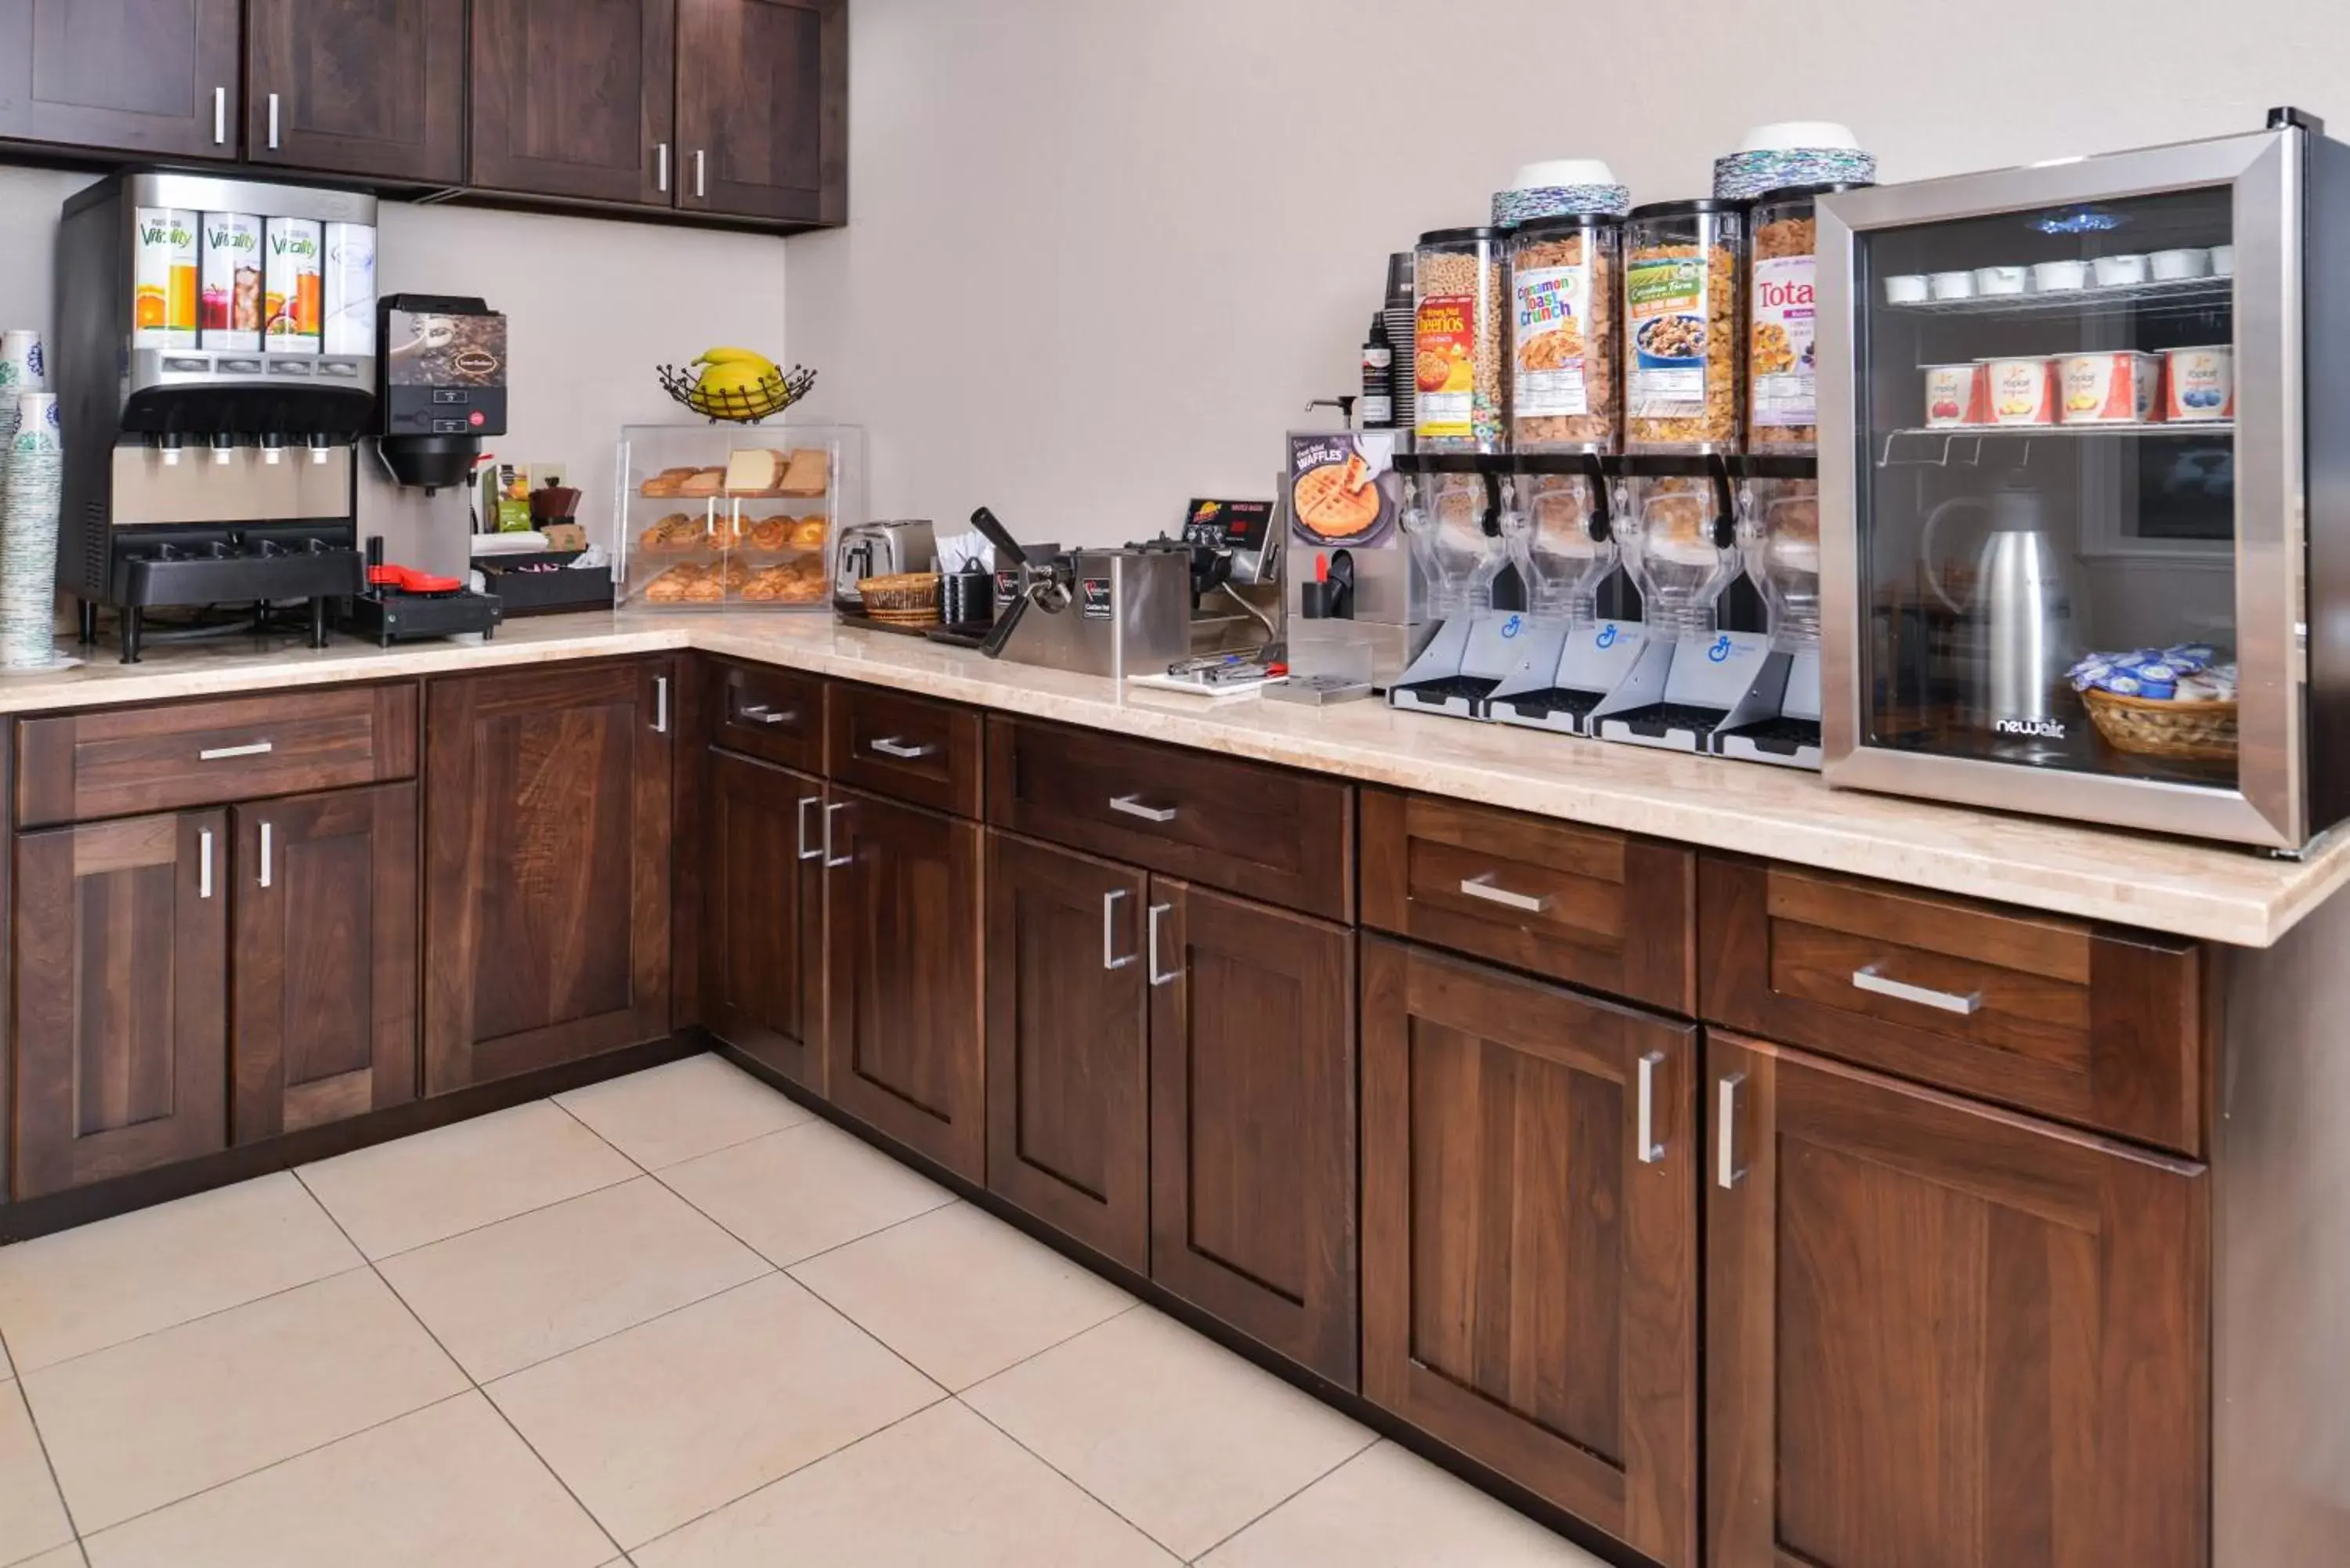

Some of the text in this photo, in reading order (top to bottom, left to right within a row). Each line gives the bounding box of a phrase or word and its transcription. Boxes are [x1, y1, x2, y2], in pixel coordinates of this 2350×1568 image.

[208, 226, 257, 253] Vitality
[271, 229, 317, 259] Viality
[1518, 278, 1569, 300] Cinnamon
[1524, 291, 1558, 311] Toast
[1296, 450, 1342, 470] WAFFLES
[1996, 718, 2066, 736] newair
